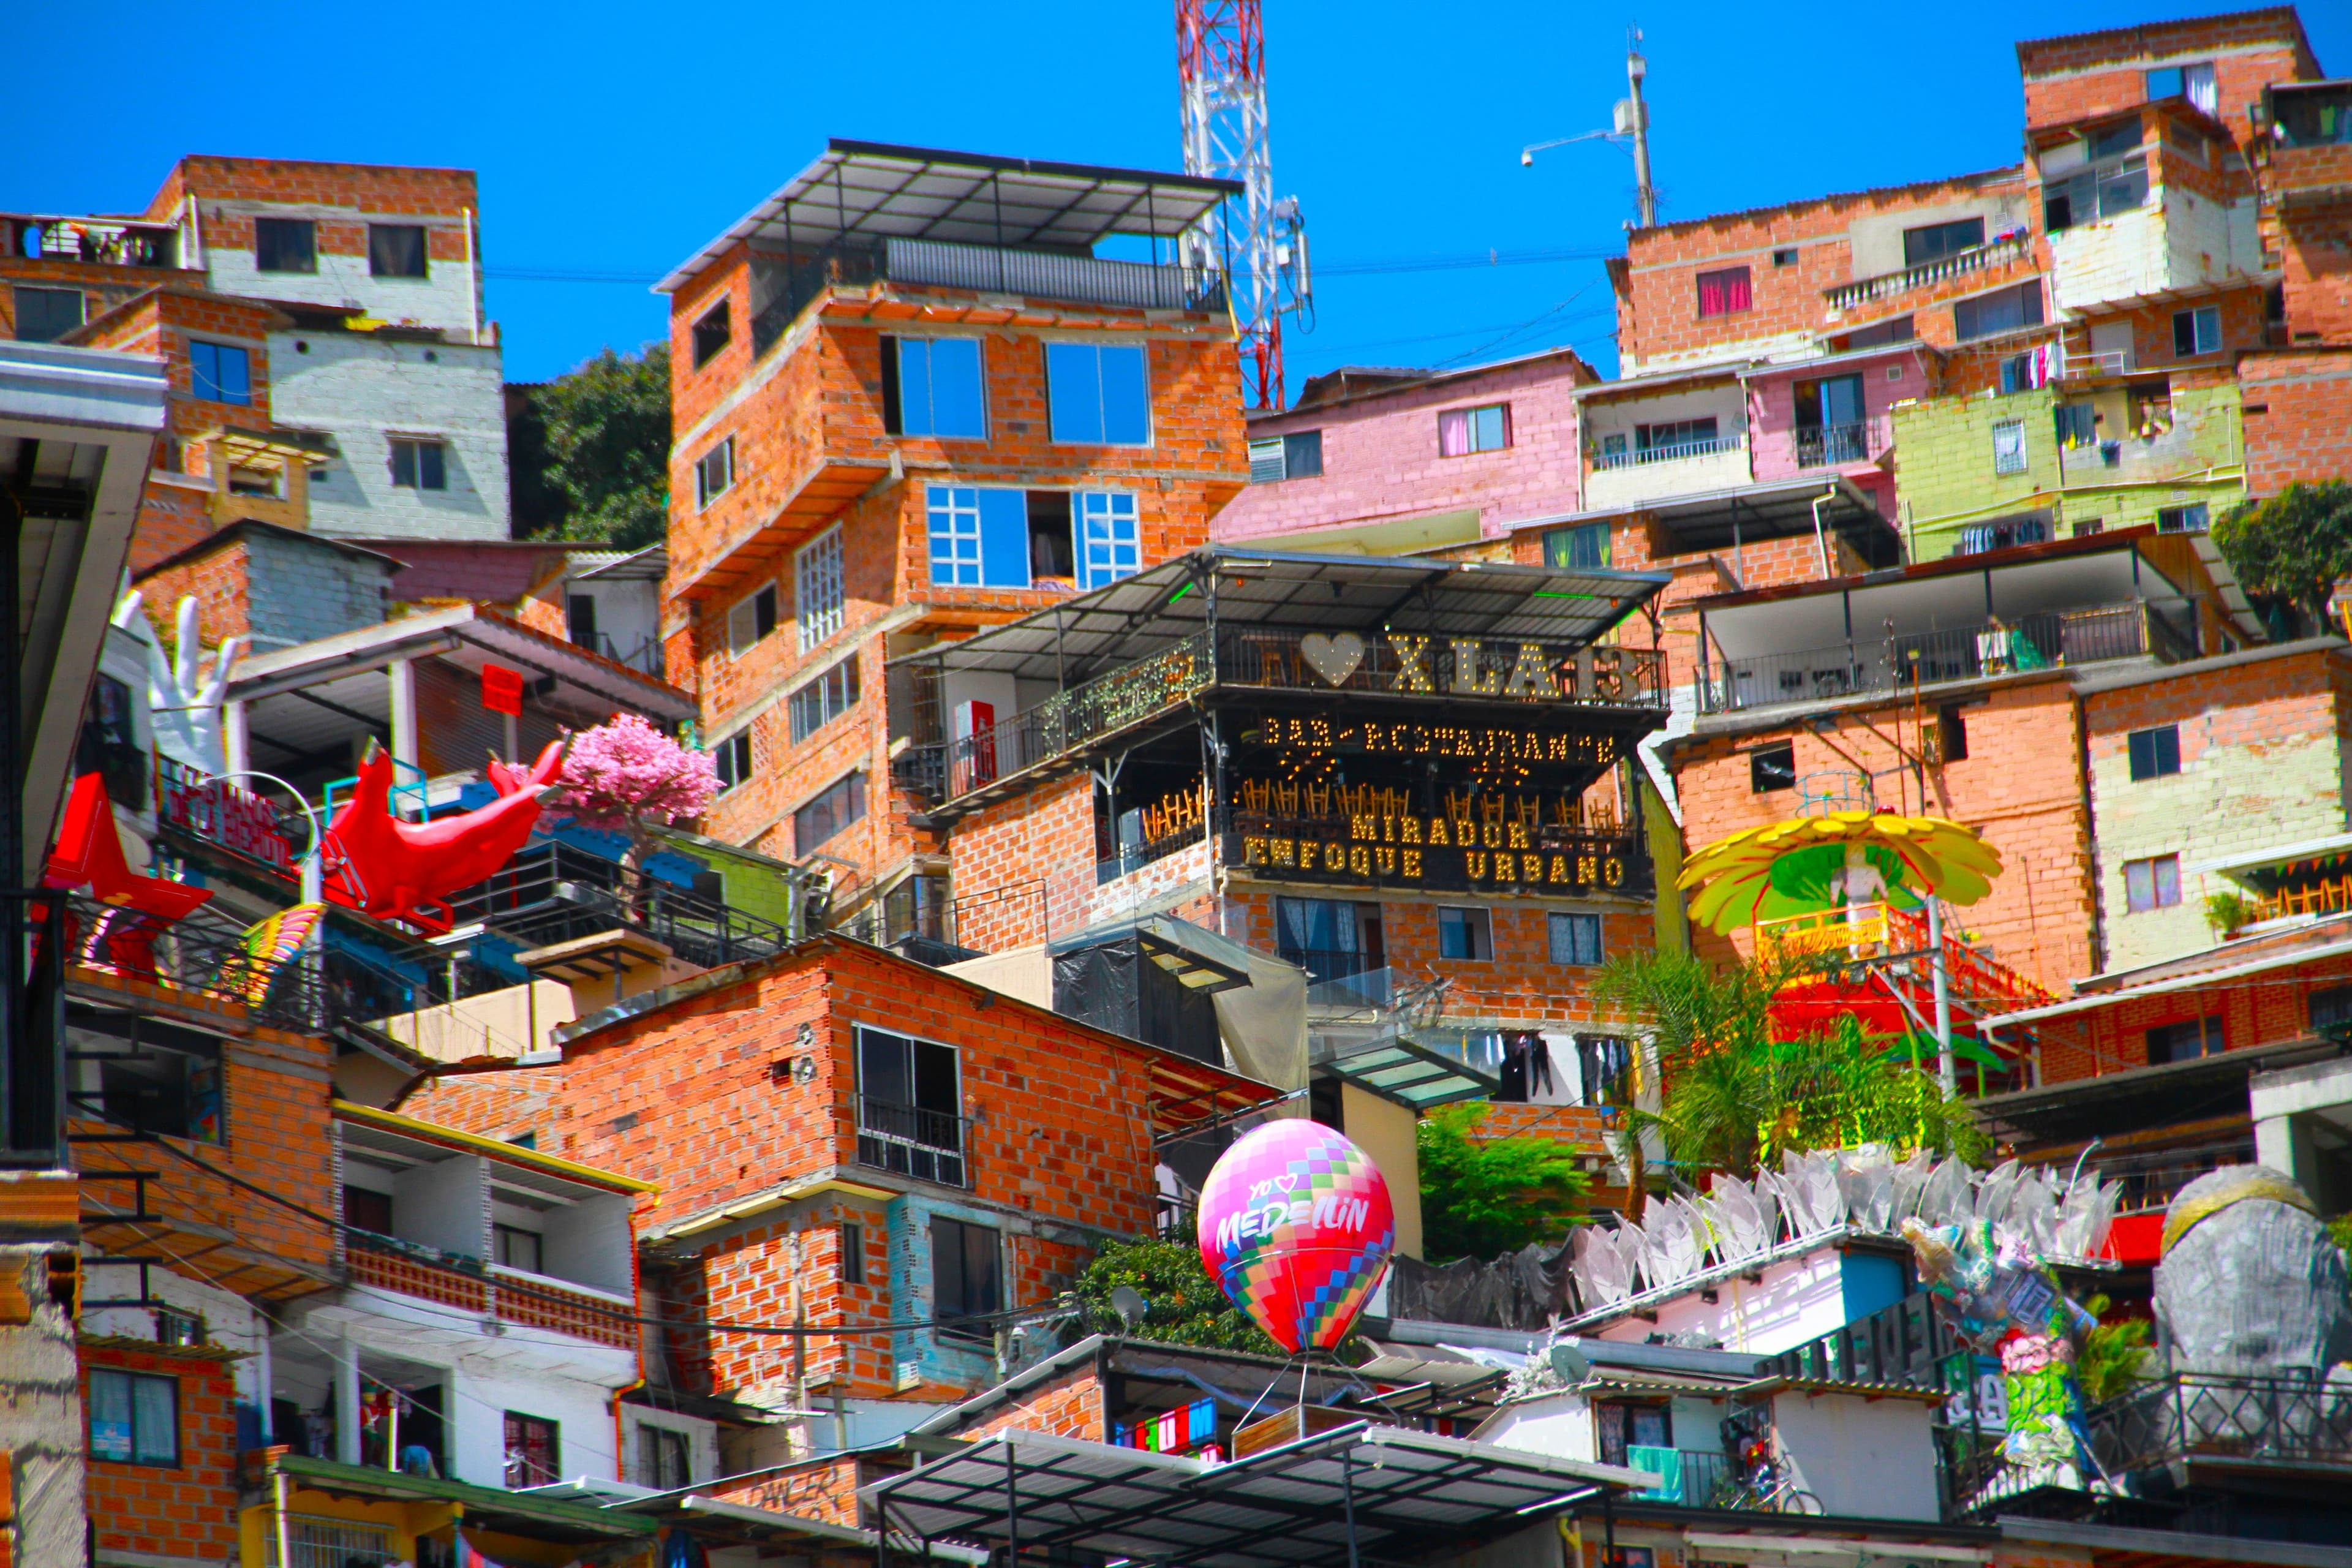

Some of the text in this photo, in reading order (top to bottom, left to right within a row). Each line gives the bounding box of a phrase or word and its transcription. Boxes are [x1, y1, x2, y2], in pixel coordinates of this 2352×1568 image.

[1351, 813, 1529, 850] MIRADOR
[1244, 836, 1623, 888] ENFOQUE URBANO
[1249, 1180, 1272, 1201] YO
